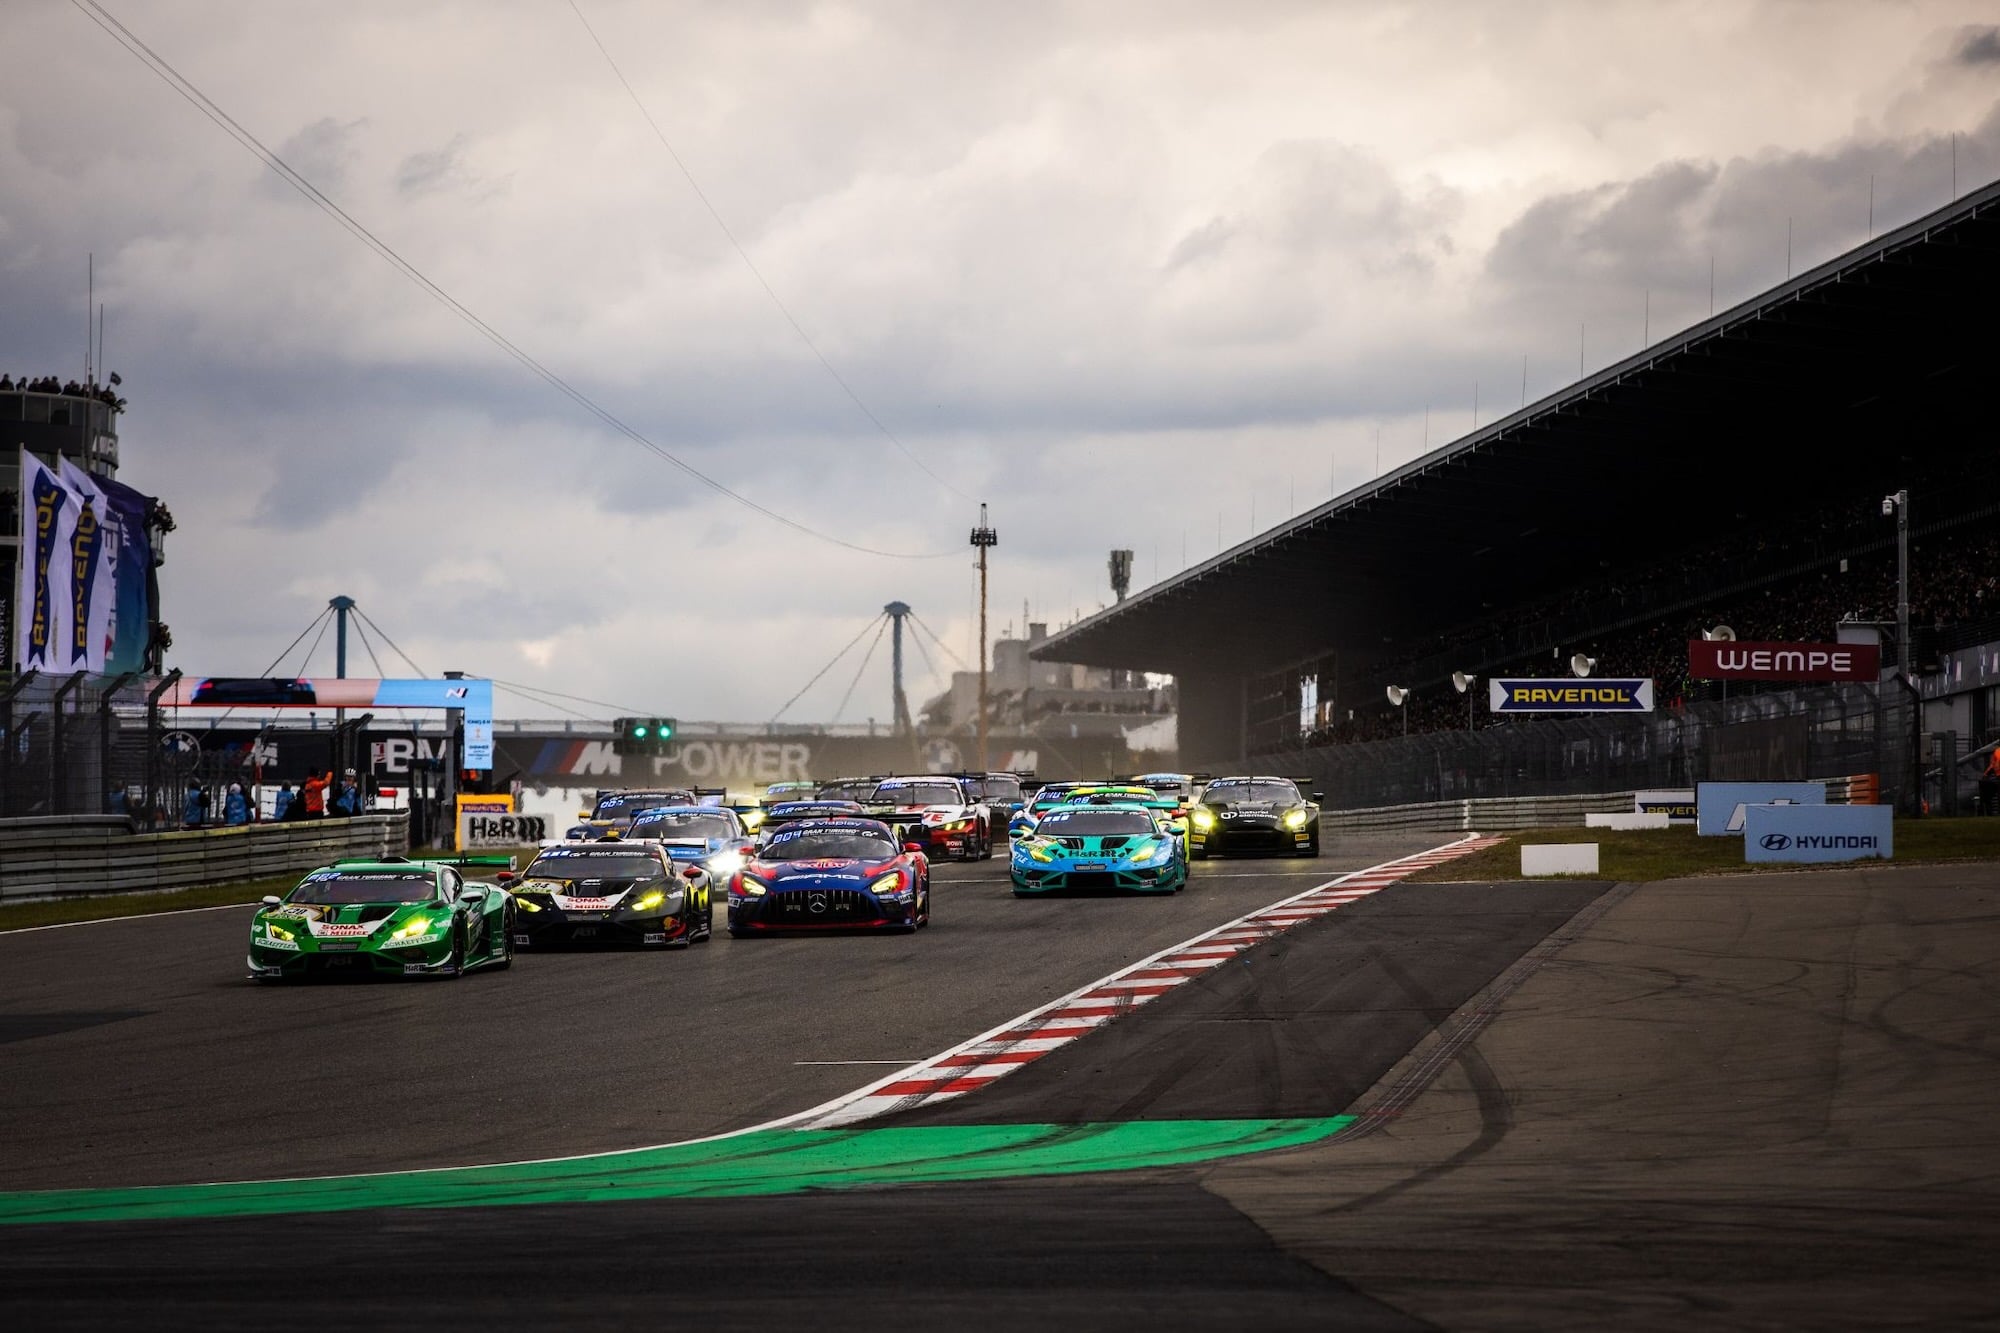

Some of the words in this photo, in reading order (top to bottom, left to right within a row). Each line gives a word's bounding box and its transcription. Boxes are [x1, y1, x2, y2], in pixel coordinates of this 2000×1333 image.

[1716, 650, 1852, 672] WEMPE
[1514, 688, 1630, 703] RAVENOL
[654, 741, 810, 777] POWER
[1646, 806, 1696, 815] RAVEN
[469, 815, 517, 840] H&R
[818, 820, 862, 828] viaplay
[1796, 834, 1878, 849] HYUNDAI
[256, 939, 297, 950] SCHAEFFLER
[384, 936, 435, 948] SCHAEFFLER
